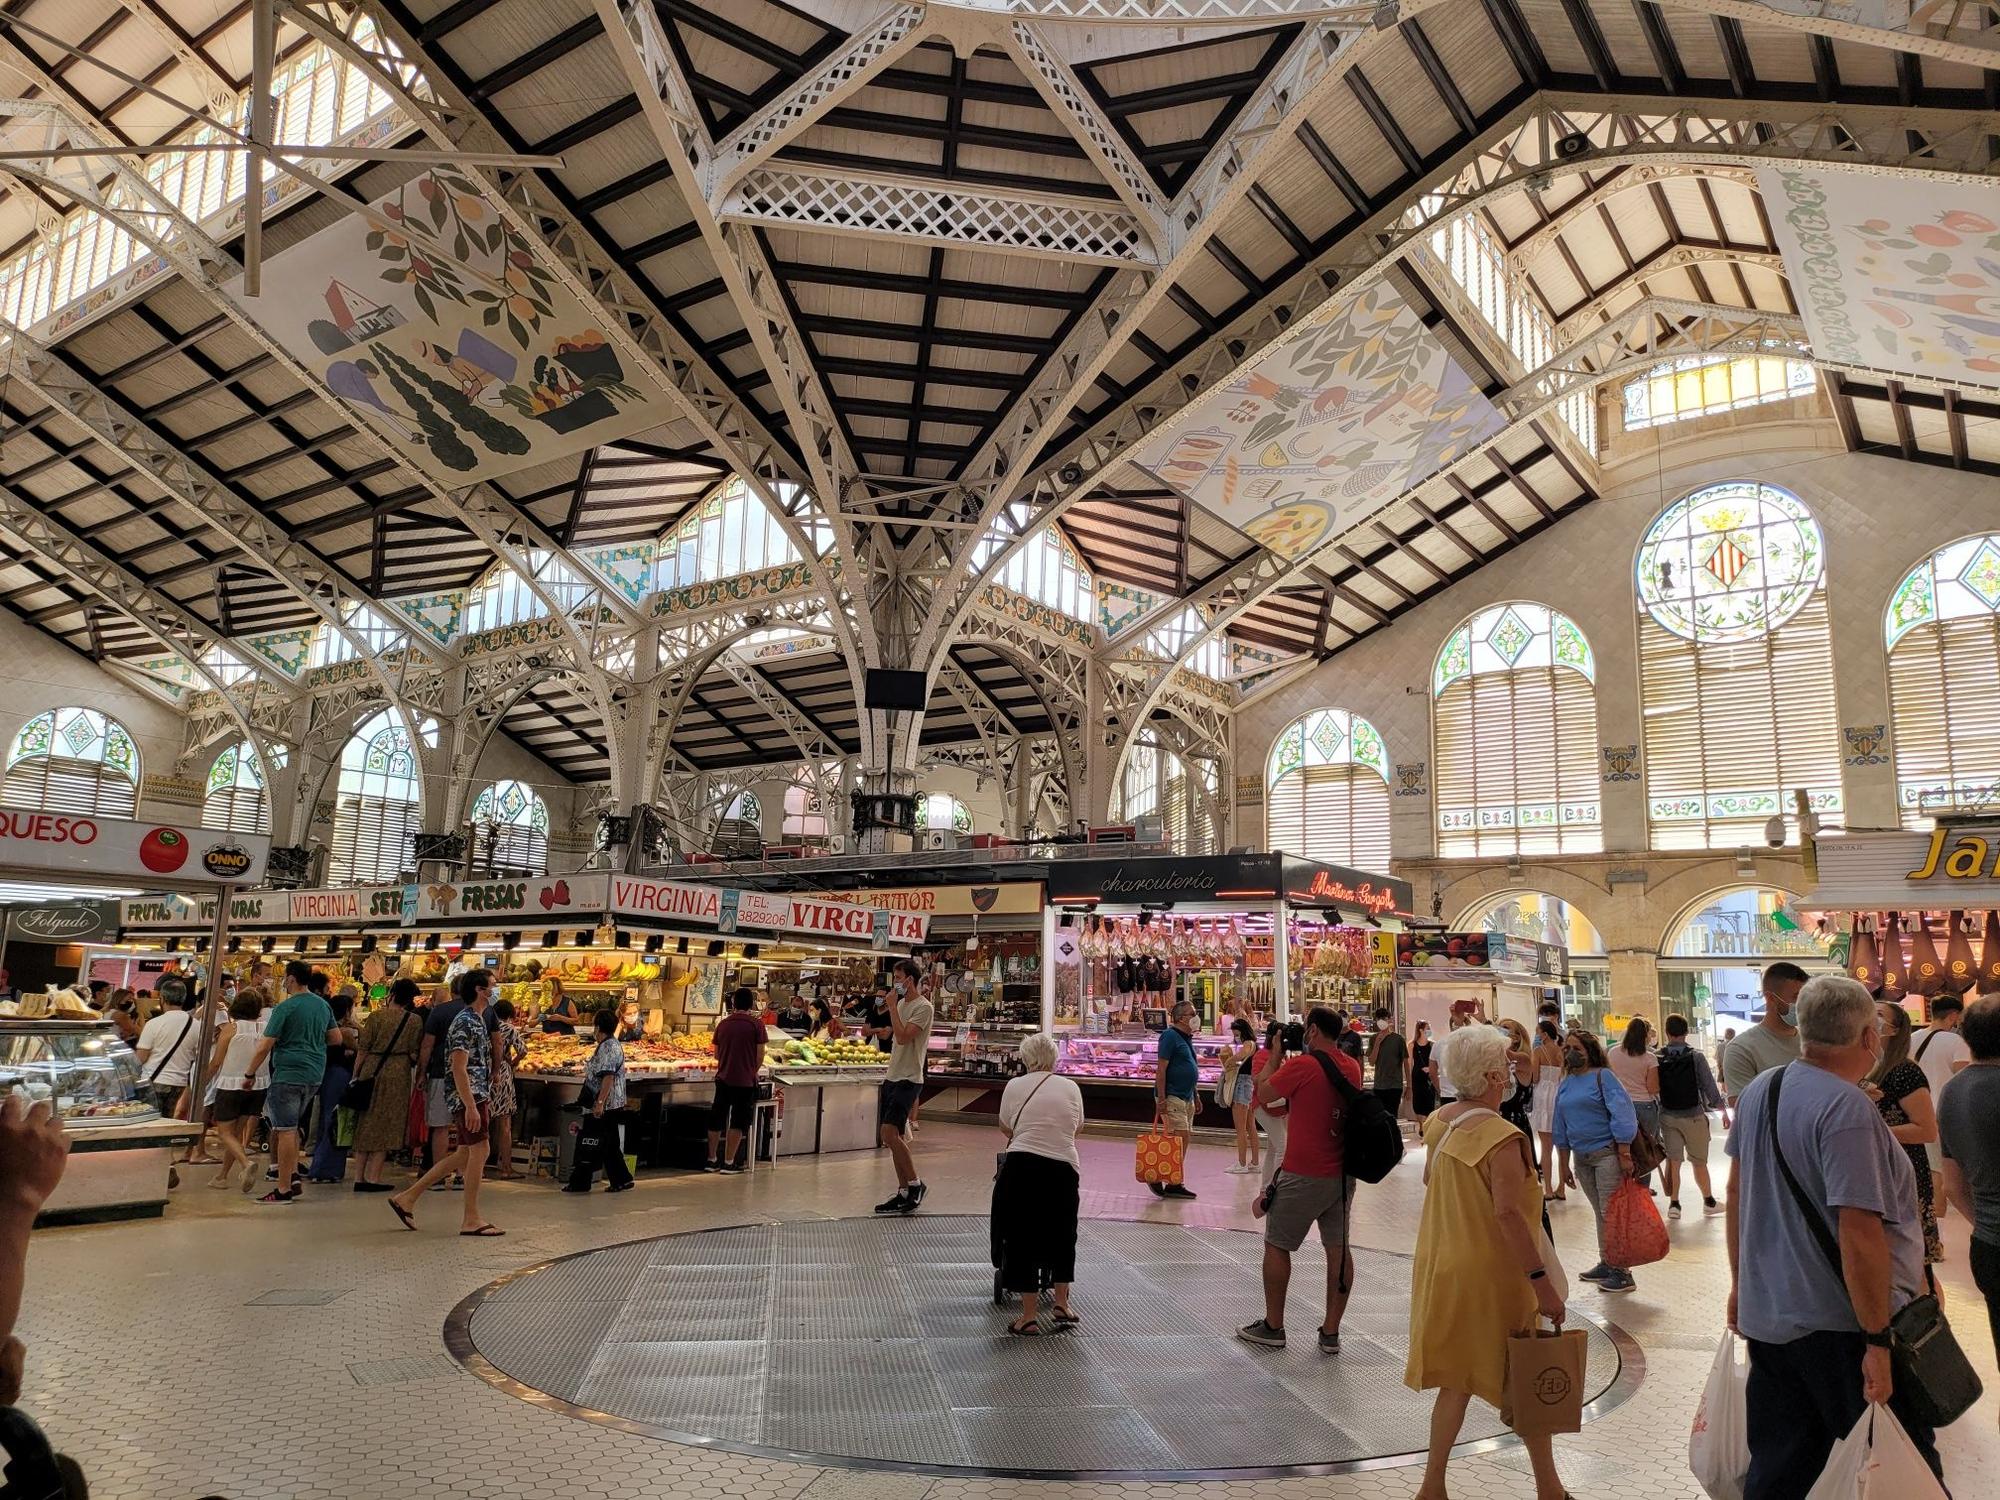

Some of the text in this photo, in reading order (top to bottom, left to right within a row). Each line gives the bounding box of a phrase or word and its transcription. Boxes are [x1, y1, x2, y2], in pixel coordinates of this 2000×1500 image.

[207, 852, 247, 867] ONNO
[1904, 828, 2000, 881] Ja
[1100, 867, 1217, 891] charcutería
[293, 894, 358, 917] VIRGINIA
[461, 882, 528, 912] FRESAS
[616, 881, 718, 917] VIRGINIA
[746, 895, 769, 909] TEL:
[24, 909, 90, 935] Folgado
[127, 902, 171, 922] FRUTAS
[200, 899, 263, 919] VEURAS
[738, 909, 787, 926] 3829206
